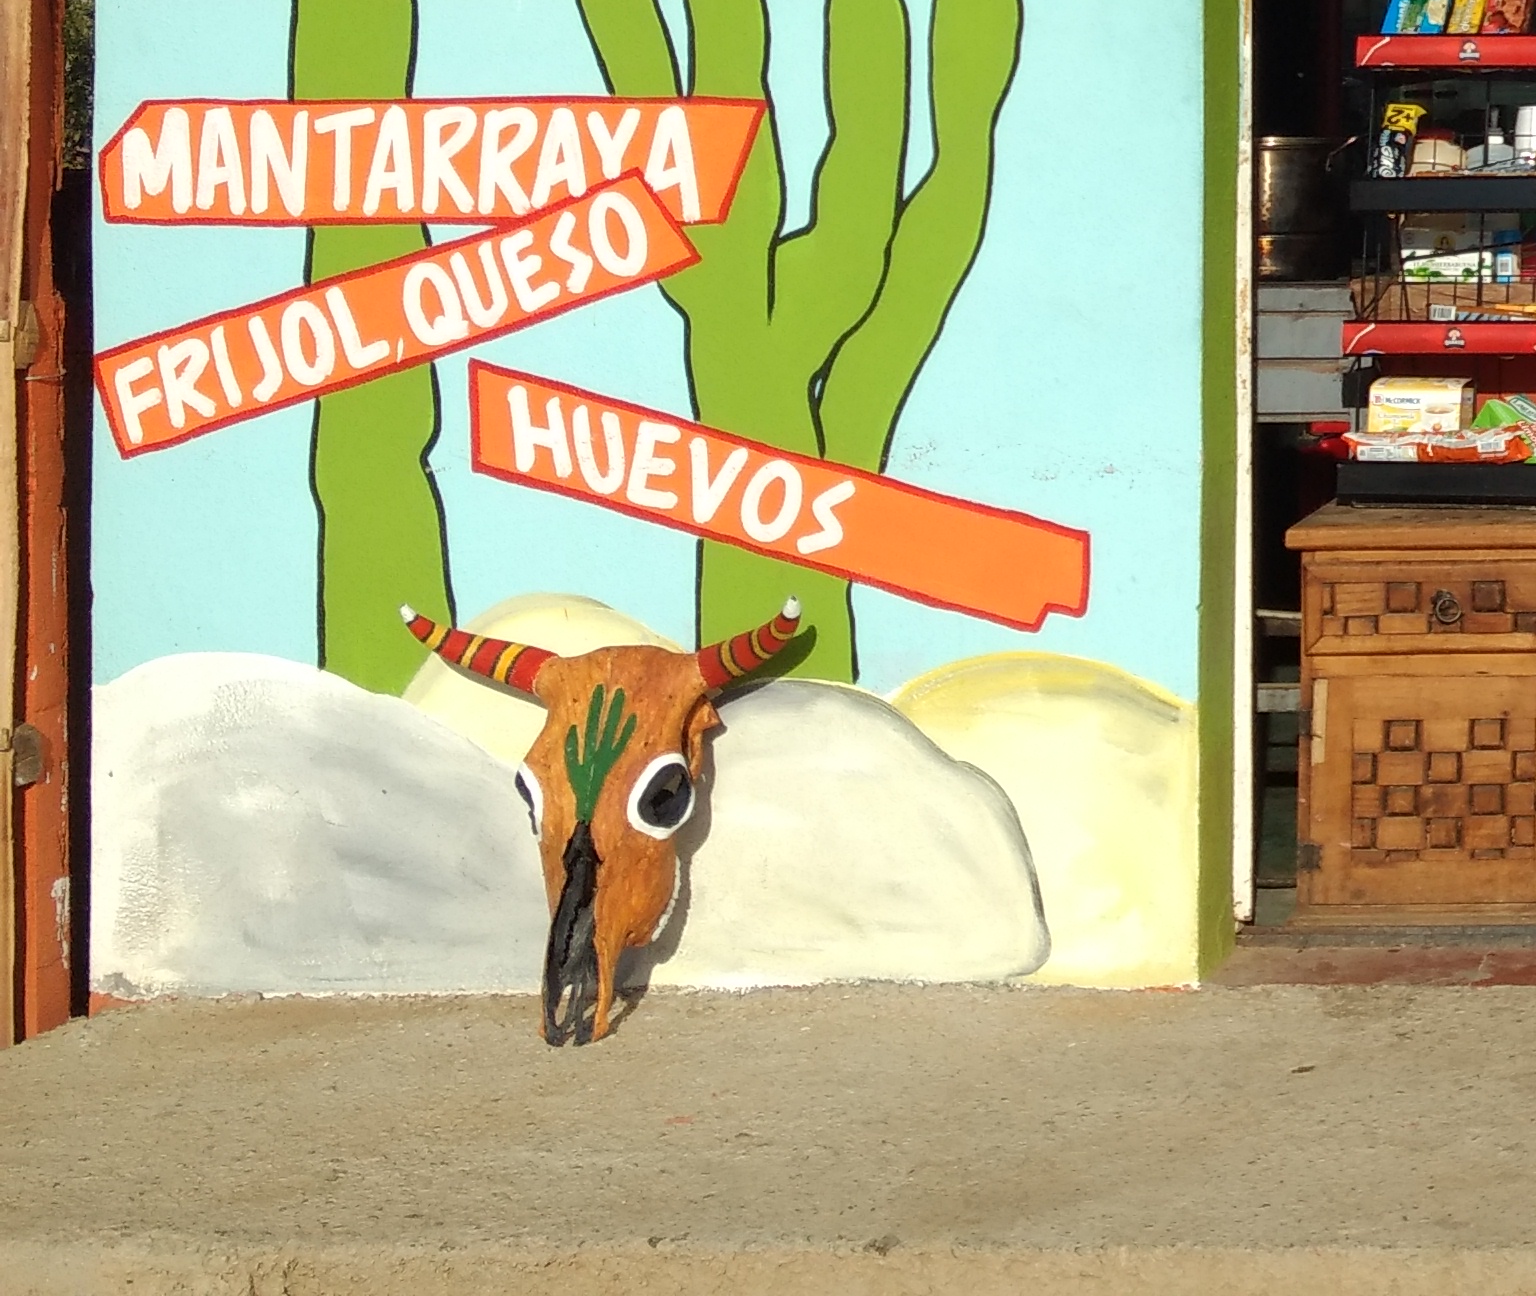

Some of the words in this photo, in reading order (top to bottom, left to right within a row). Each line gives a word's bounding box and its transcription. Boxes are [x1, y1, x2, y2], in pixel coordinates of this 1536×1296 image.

[122, 105, 702, 224] MANTARRAYA
[401, 191, 648, 348] QUESO
[114, 287, 406, 443] FRIJOL,
[507, 385, 856, 554] HUEVOS
